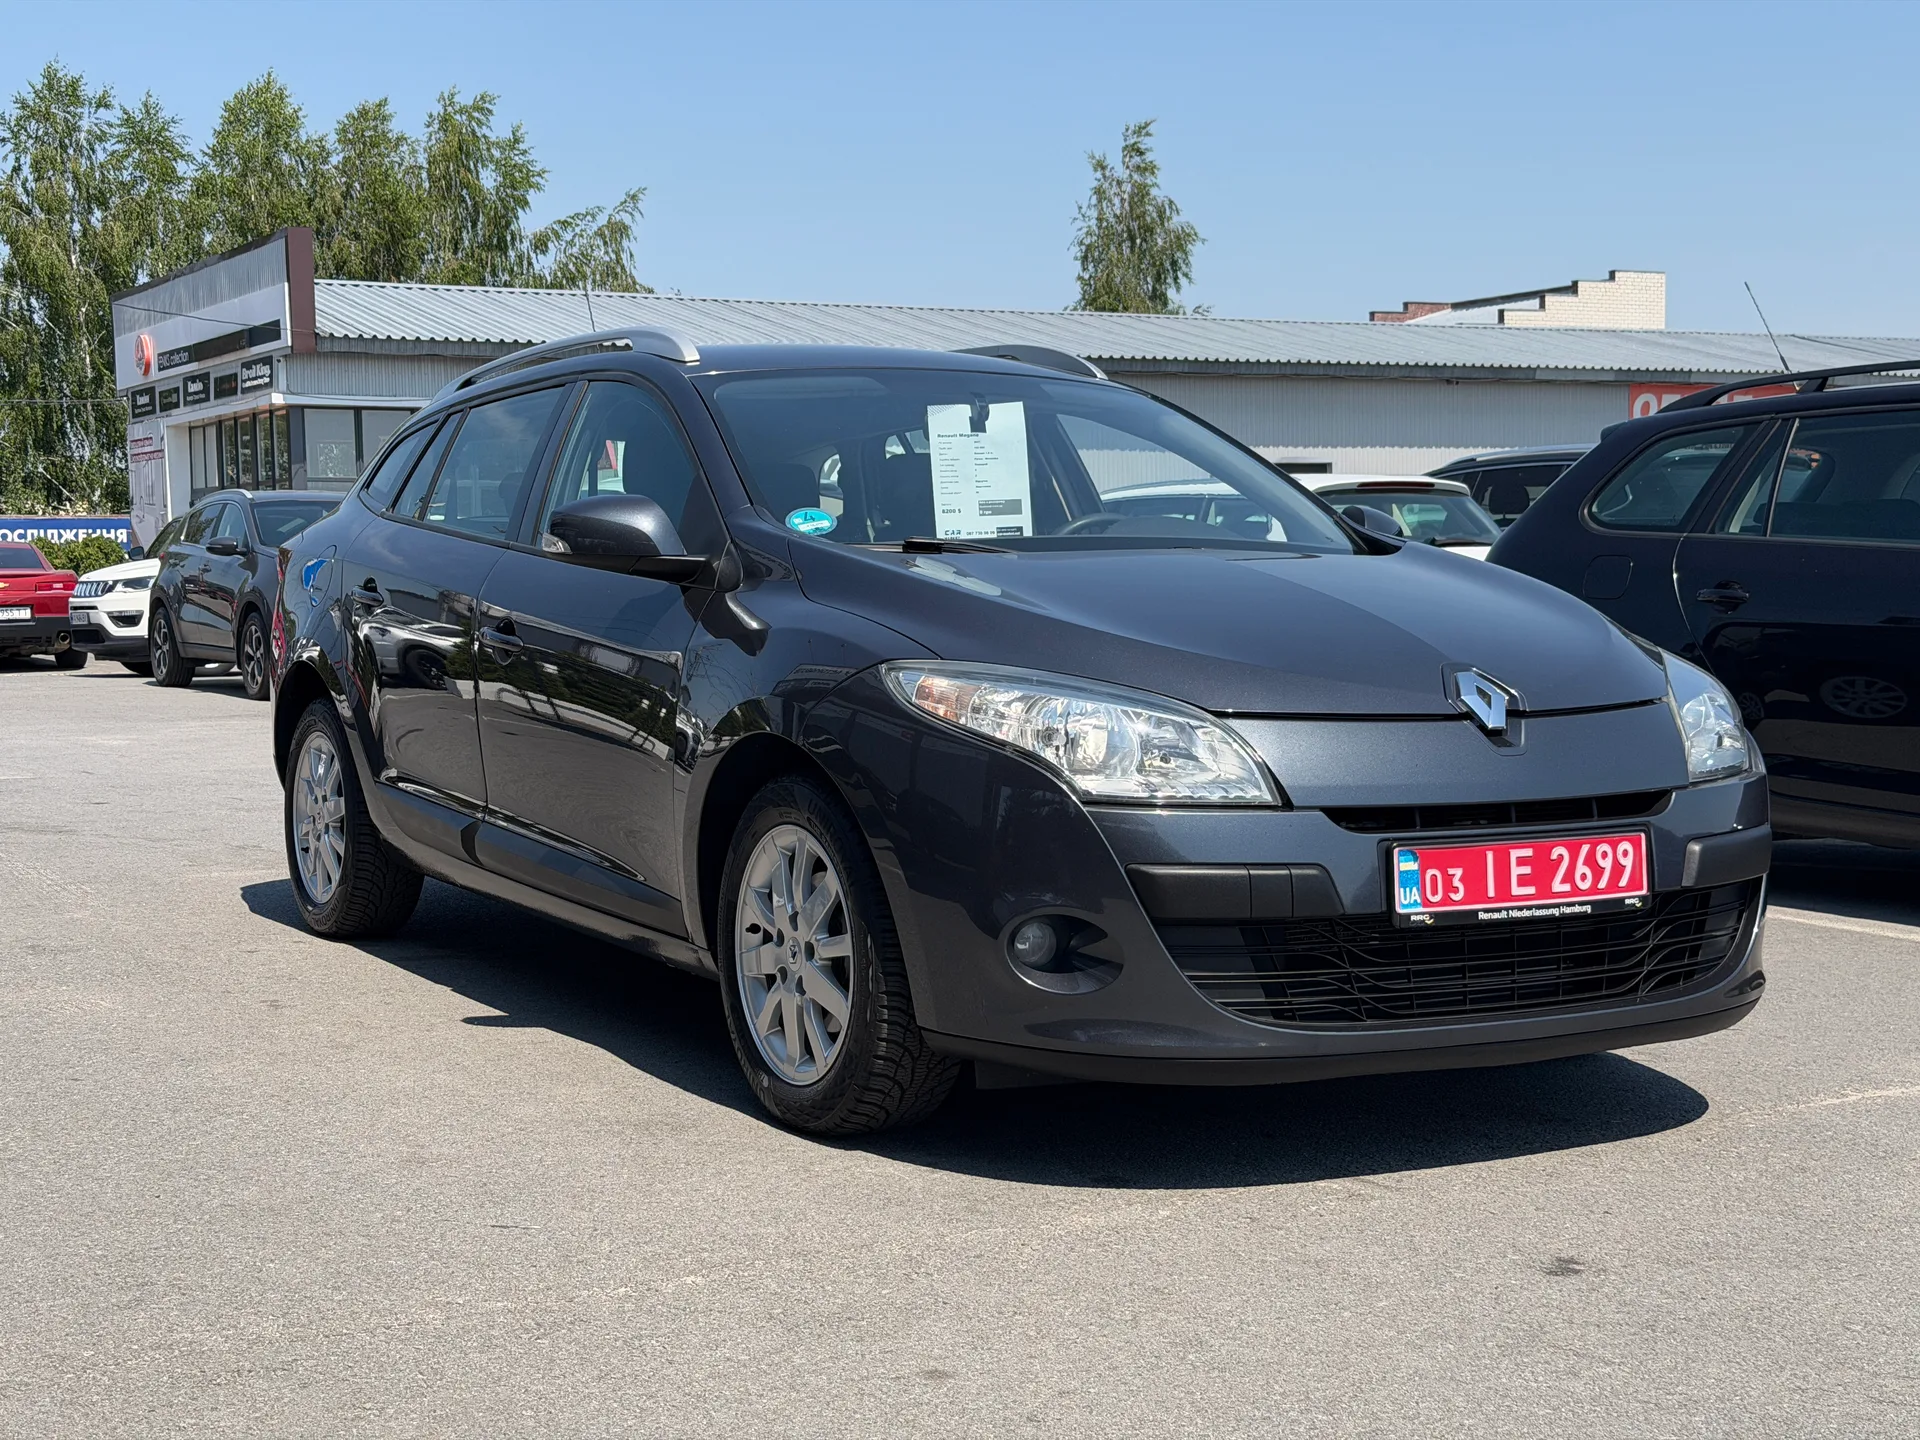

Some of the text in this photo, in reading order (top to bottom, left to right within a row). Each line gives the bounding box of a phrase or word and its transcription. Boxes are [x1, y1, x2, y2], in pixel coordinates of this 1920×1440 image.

[242, 364, 256, 380] Broil
[1425, 841, 1634, 903] 03 IE 2699
[1400, 887, 1421, 904] UA
[1624, 897, 1640, 905] RRG
[1410, 914, 1430, 922] RRG
[1478, 904, 1592, 920] Renault Niederlassung Hamburg
